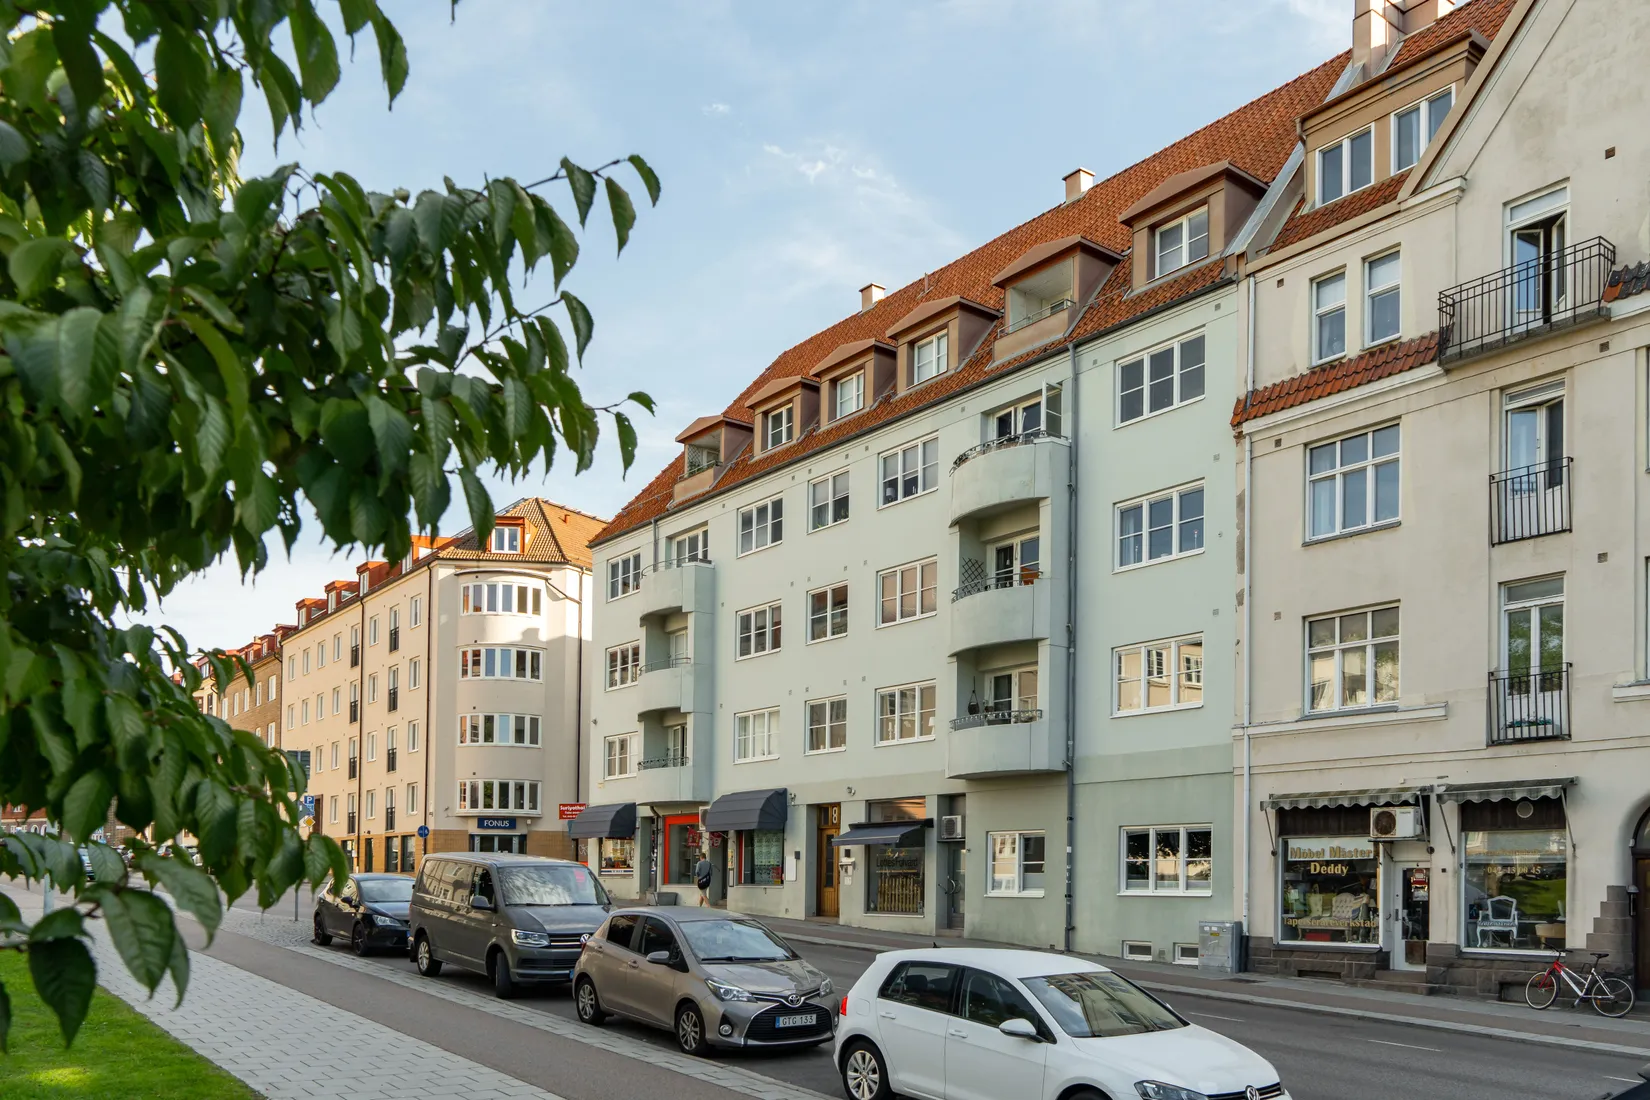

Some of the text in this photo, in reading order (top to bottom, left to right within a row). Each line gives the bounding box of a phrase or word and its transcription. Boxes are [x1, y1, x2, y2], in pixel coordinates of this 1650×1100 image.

[306, 796, 313, 804] P
[833, 807, 838, 823] 8
[1290, 846, 1373, 859] Möbel Mäster
[1310, 862, 1349, 876] Deddy
[782, 1015, 814, 1026] GTG 133
